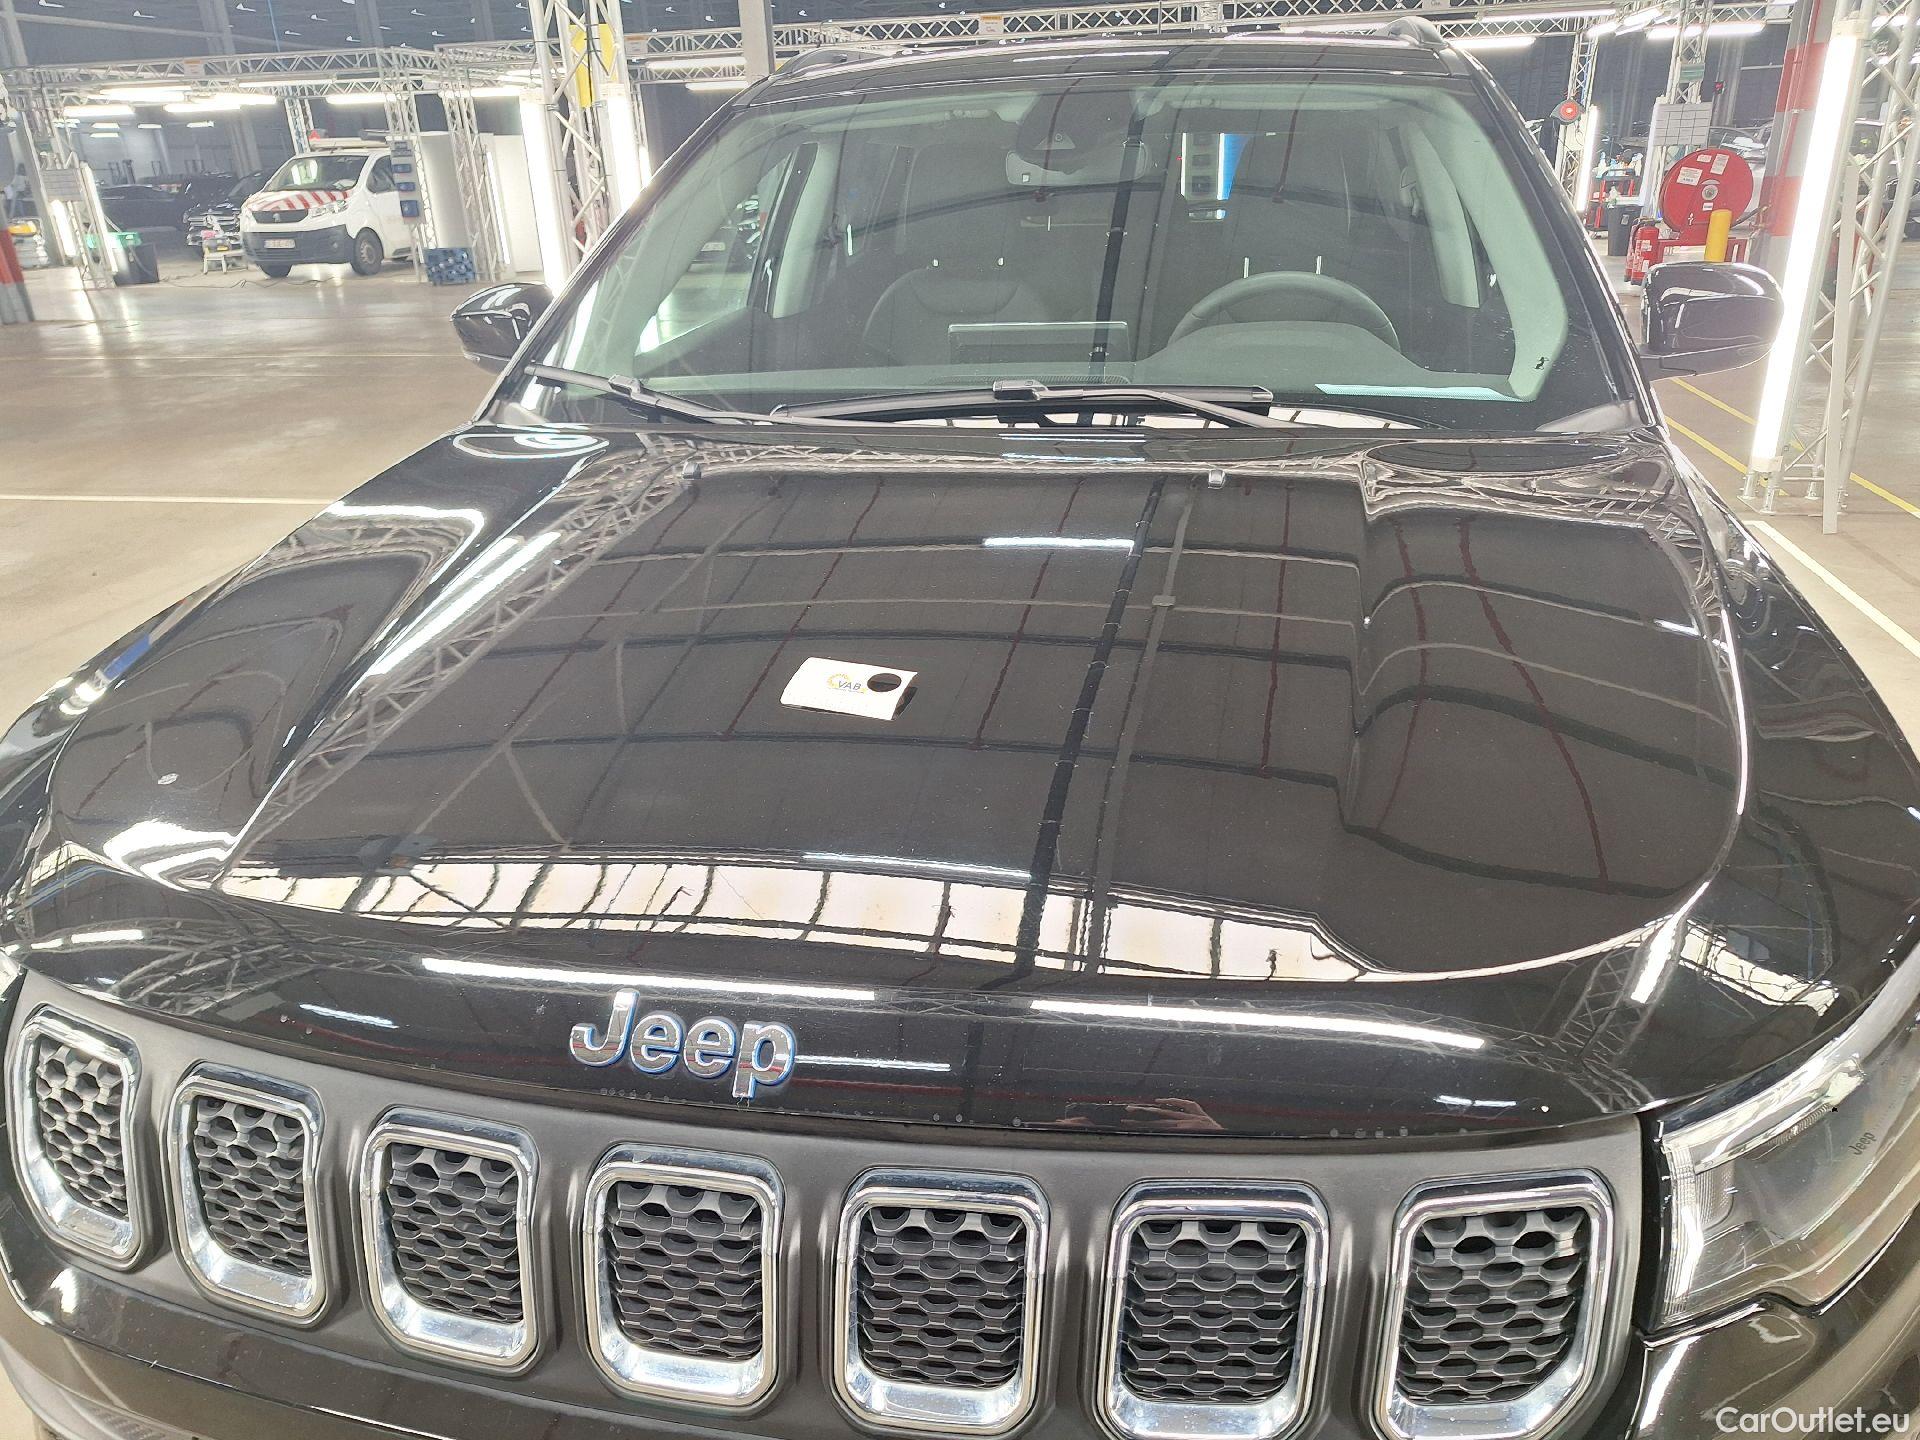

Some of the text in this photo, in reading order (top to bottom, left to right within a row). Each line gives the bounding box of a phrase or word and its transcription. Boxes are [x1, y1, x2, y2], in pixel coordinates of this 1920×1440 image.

[838, 680, 861, 690] VAB
[570, 988, 796, 1099] Jeep
[1848, 1132, 1877, 1155] Jeep
